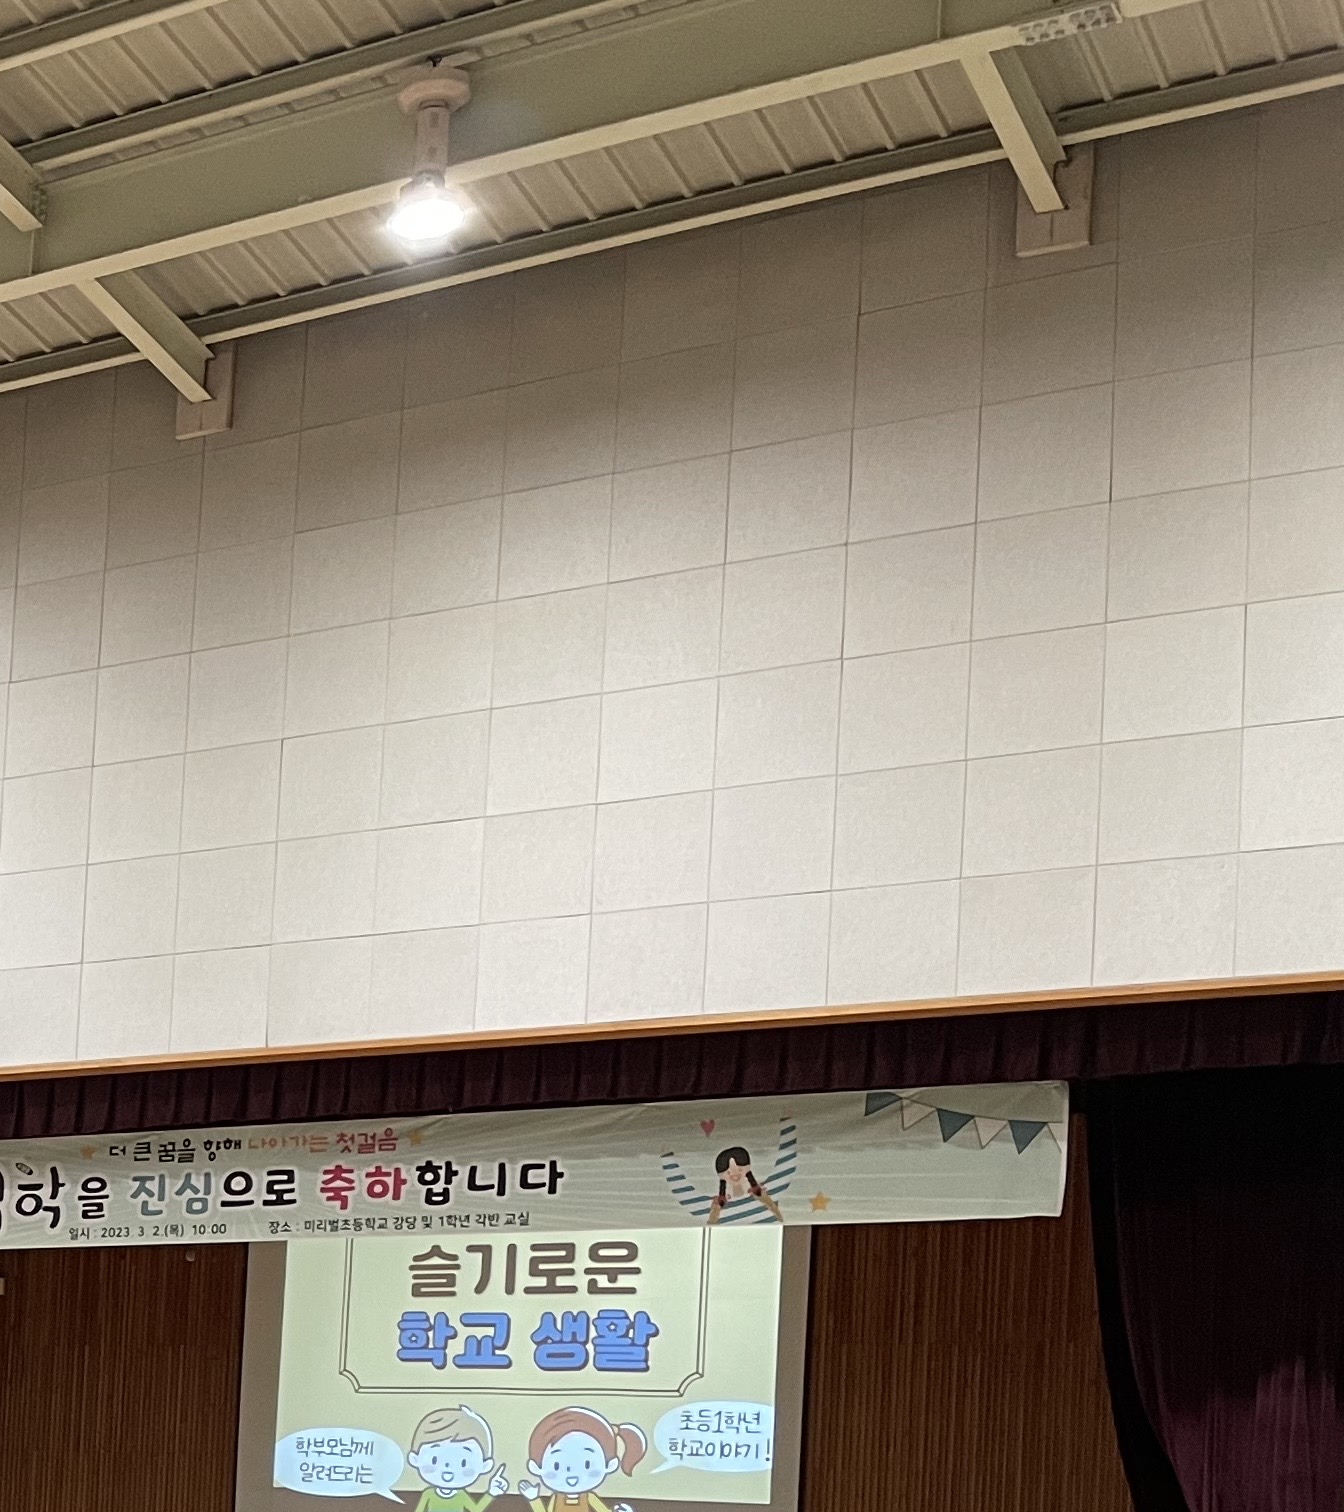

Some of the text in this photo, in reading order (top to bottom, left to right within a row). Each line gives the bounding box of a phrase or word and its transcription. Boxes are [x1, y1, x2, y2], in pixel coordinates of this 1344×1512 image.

[109, 1126, 400, 1164] 더 큰 꿈을 향해 나아가는 첫걸음
[129, 1169, 297, 1217] 진심으로
[319, 1159, 565, 1211] 축하합니다
[69, 1226, 91, 1241] 일시
[191, 1222, 227, 1236] 10:00
[269, 1220, 293, 1235] 장소
[304, 1216, 388, 1233] 미리벌초등학교
[393, 1214, 417, 1230] 강당
[421, 1213, 433, 1229] 및
[438, 1212, 471, 1229] 1학년
[503, 1210, 531, 1227] 교실
[407, 1240, 642, 1298] 슬기로운
[396, 1308, 660, 1373] 학교 생활
[296, 1437, 375, 1458] 학부모님께
[299, 1461, 374, 1484] 알려드리는
